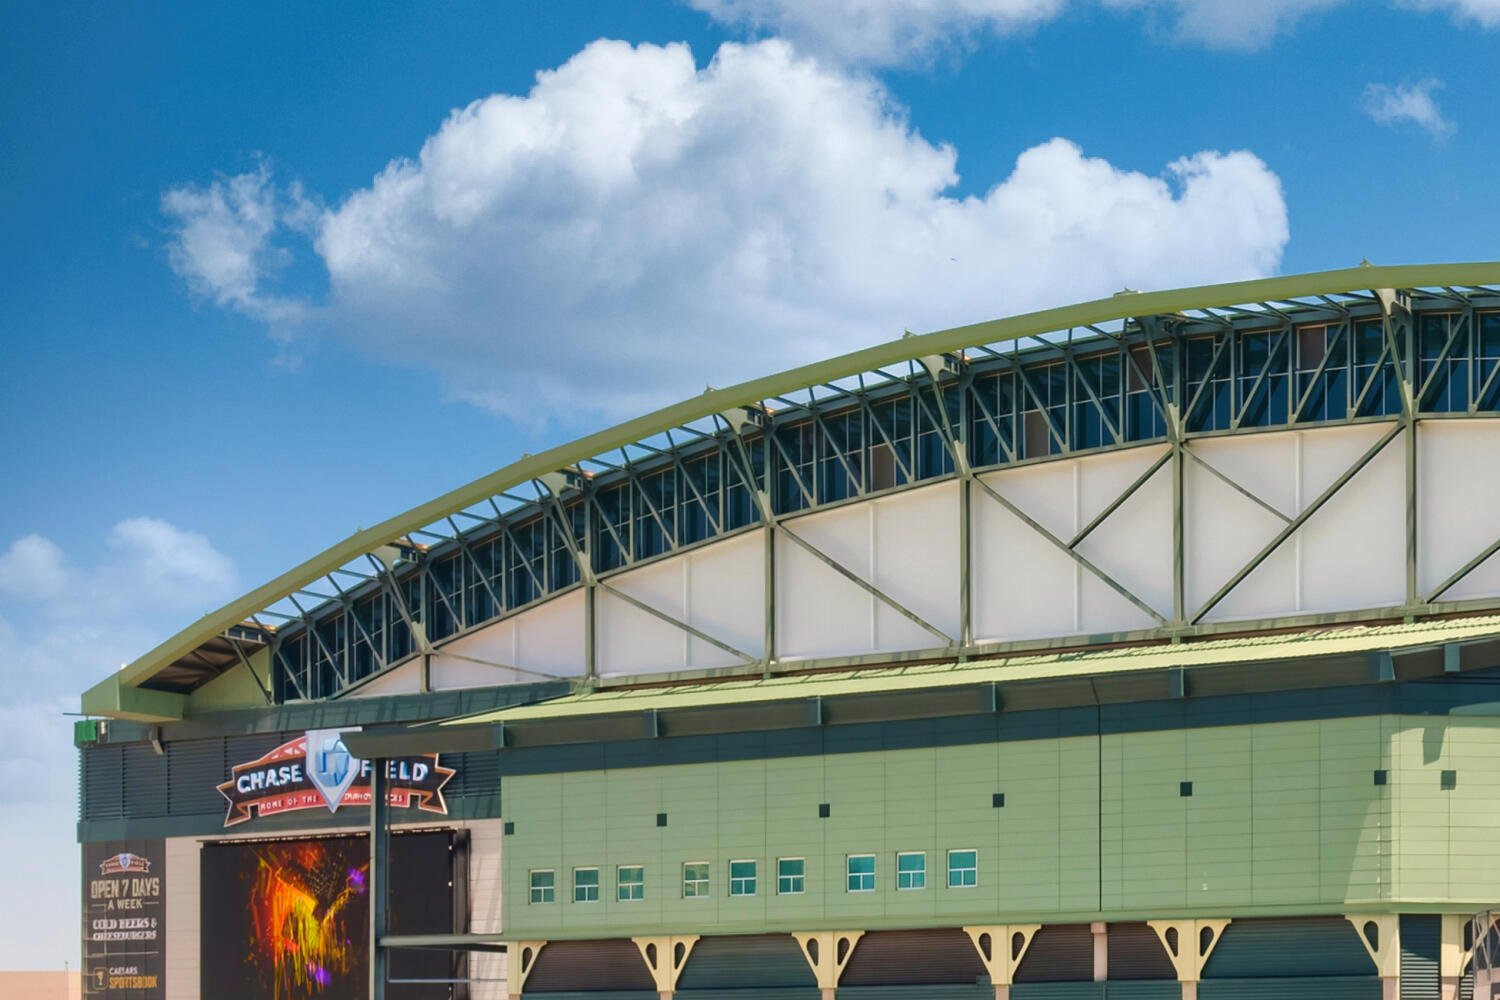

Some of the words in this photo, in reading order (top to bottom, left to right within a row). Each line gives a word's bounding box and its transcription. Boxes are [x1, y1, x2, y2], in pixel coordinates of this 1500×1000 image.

[237, 763, 303, 793] CHASE
[361, 759, 428, 781] FELD
[302, 795, 317, 803] THE
[91, 880, 119, 898] OPEN
[122, 879, 129, 896] 7
[132, 878, 160, 897] DAYS
[108, 900, 114, 909] A
[117, 898, 143, 909] WEEK
[92, 919, 117, 930] COLD
[109, 967, 138, 975] CAESARS
[109, 976, 158, 989] SPORTSBOOK
